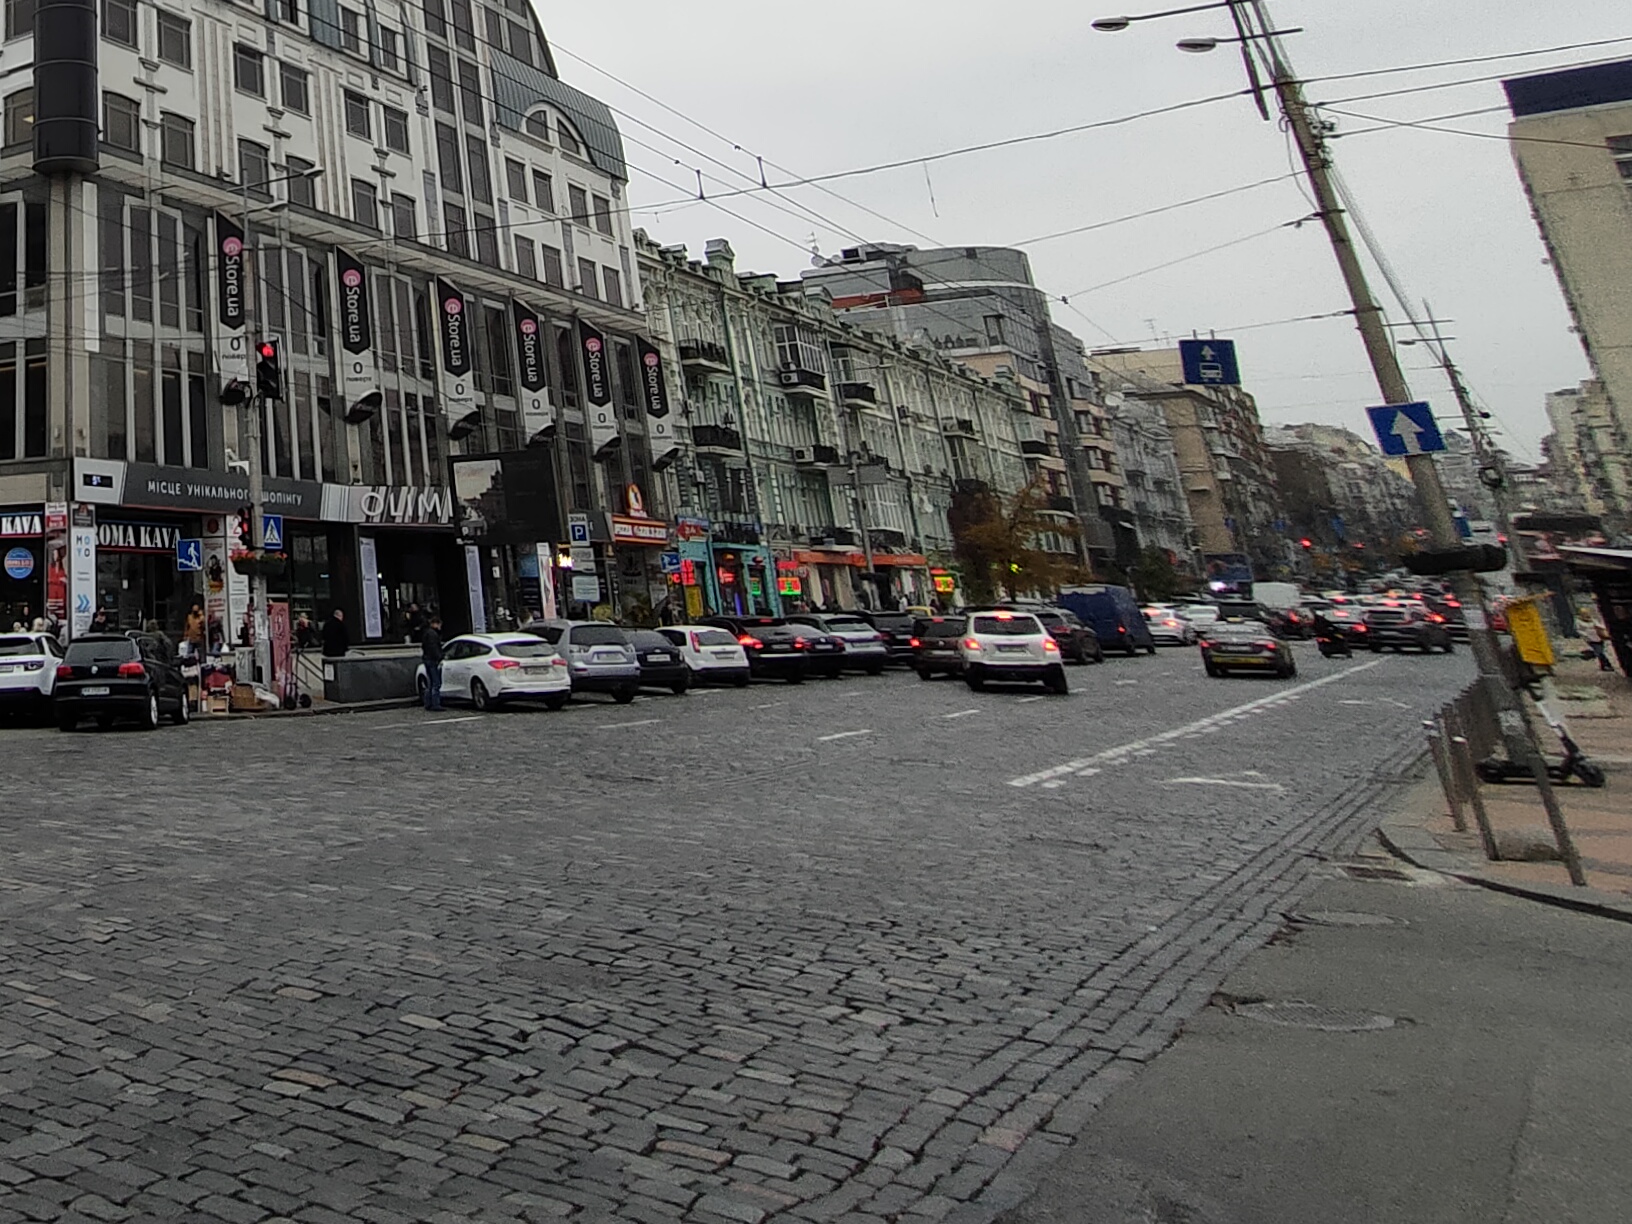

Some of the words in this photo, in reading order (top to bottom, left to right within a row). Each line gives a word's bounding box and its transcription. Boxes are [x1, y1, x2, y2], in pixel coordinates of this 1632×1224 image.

[222, 237, 242, 317] eStore.ua
[342, 269, 362, 343] eStore.ua
[444, 298, 463, 366] eStore.ua
[520, 318, 538, 383] eStore.ua
[585, 337, 604, 398] eStore.ua
[643, 352, 662, 410] eStore.ua
[147, 480, 181, 495] МІСЦЕ
[187, 484, 251, 500] УНІКАЛЬНОГ
[1, 515, 42, 534] KAVA
[139, 526, 180, 549] KAVA
